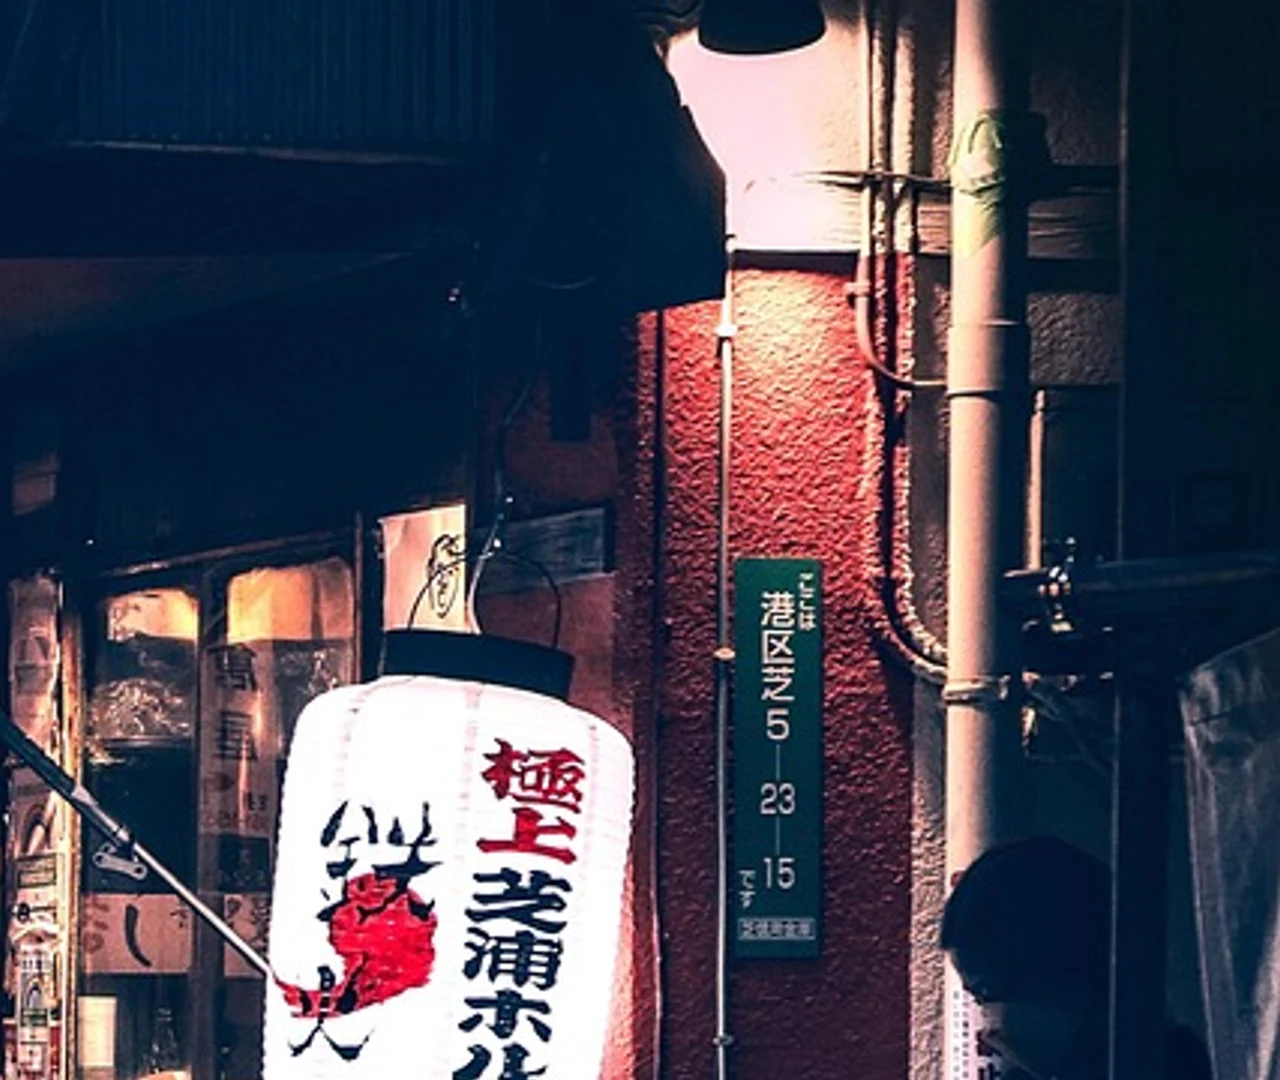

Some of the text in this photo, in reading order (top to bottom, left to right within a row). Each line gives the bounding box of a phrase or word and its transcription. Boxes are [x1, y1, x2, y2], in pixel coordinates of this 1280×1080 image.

[798, 572, 816, 632] ここは
[738, 869, 757, 909] です
